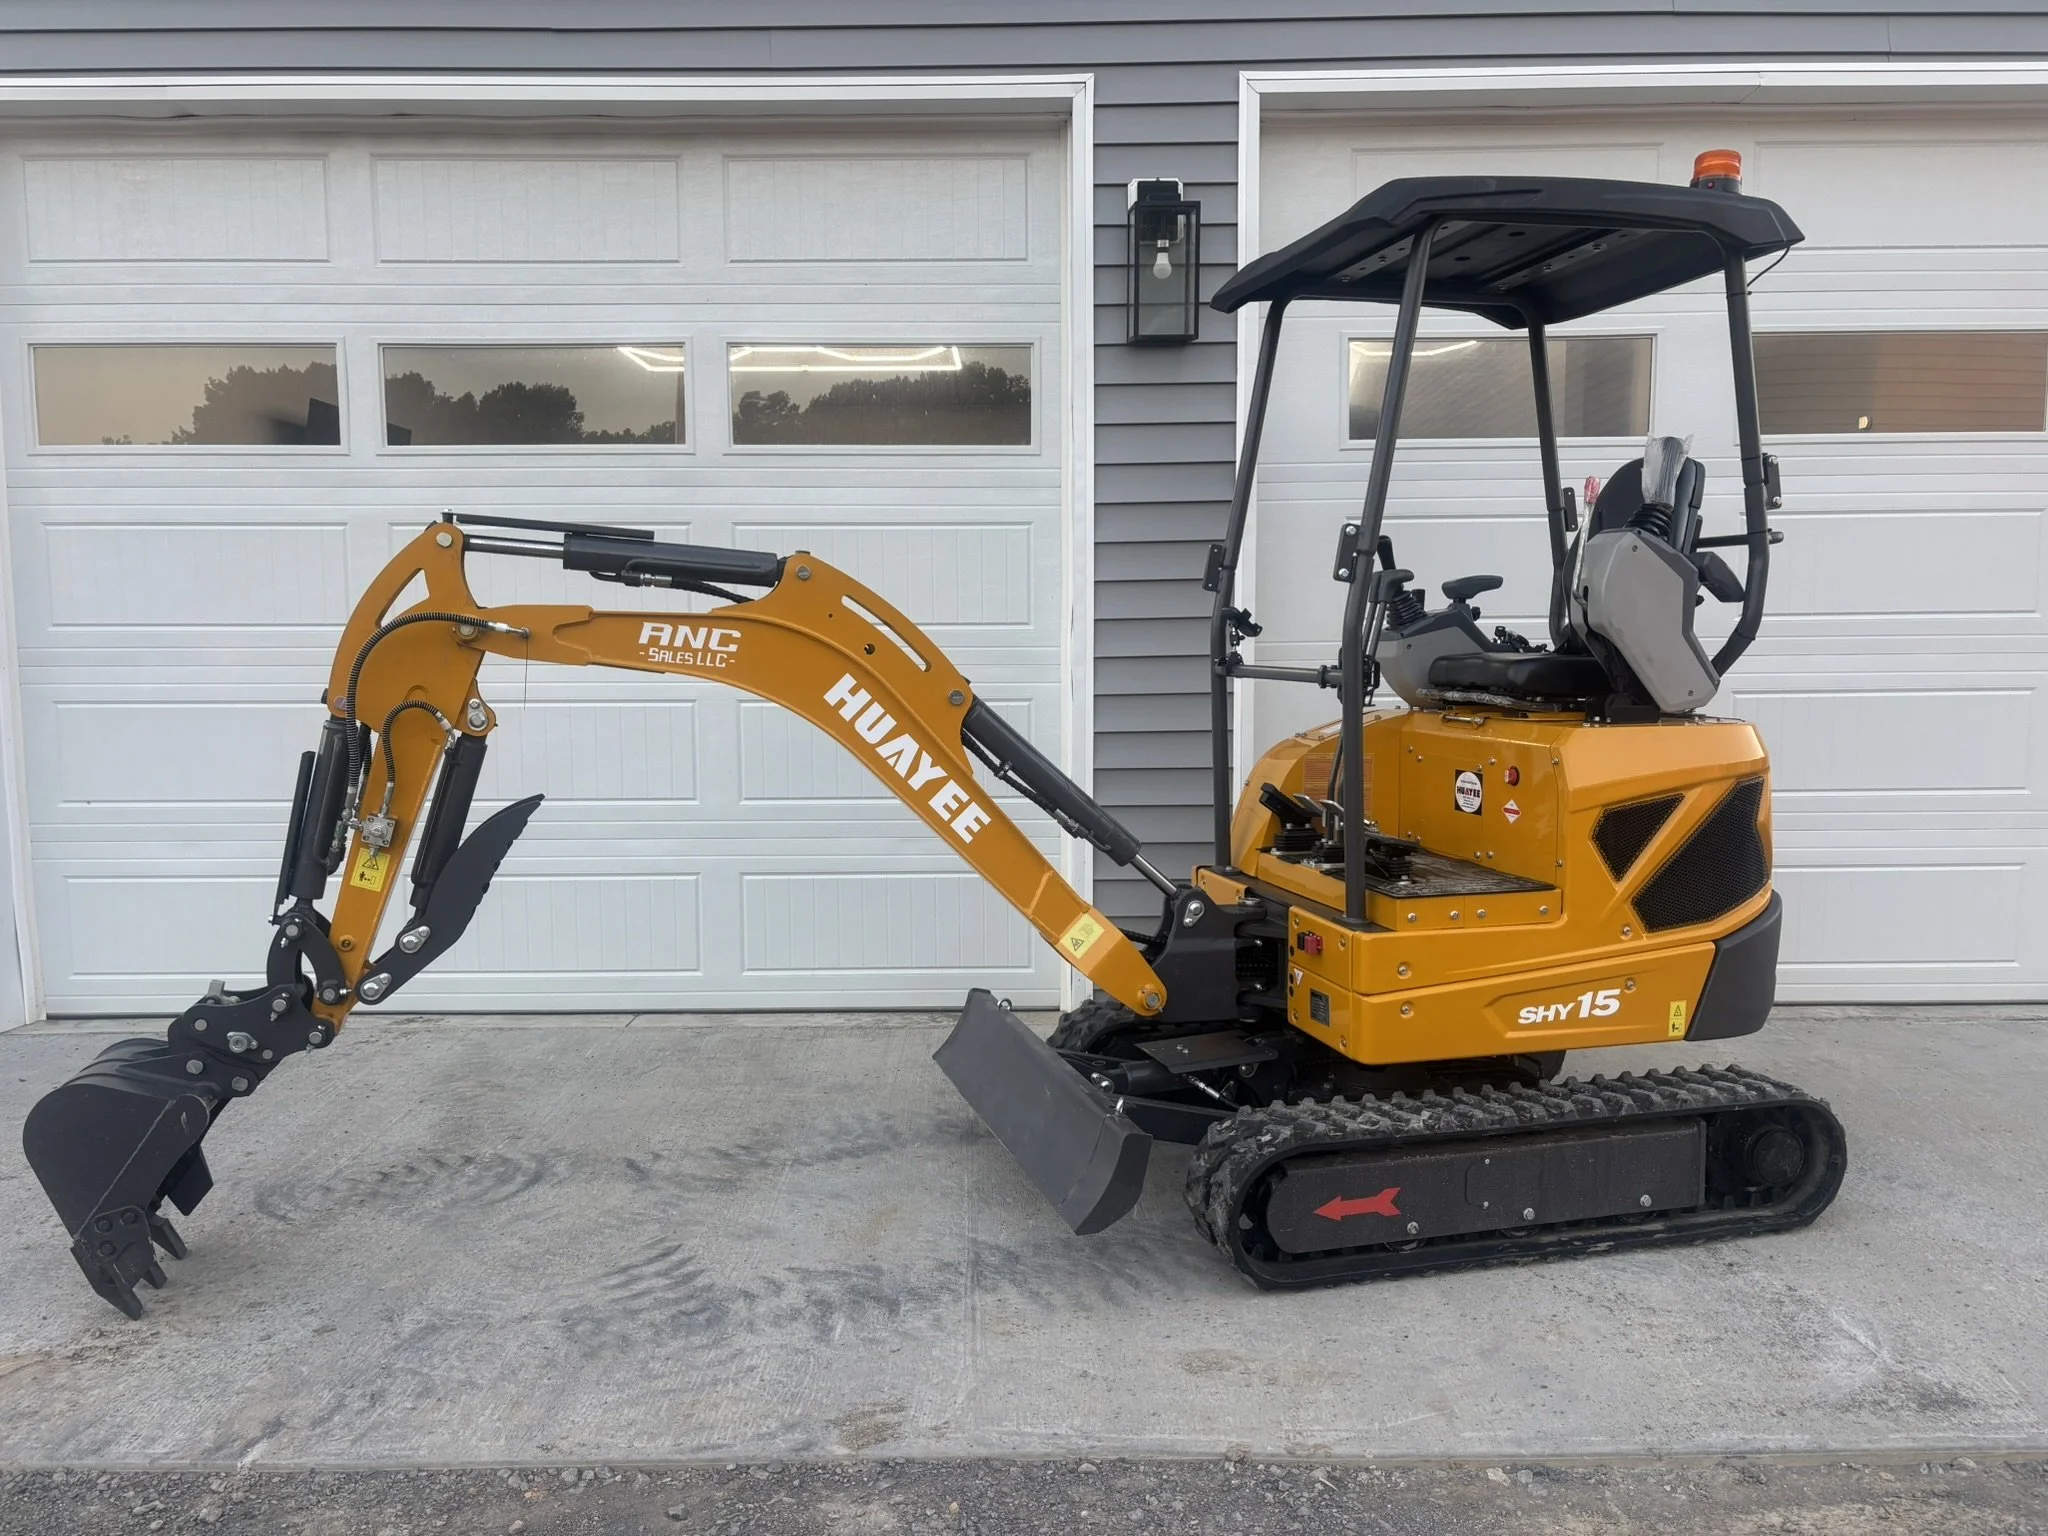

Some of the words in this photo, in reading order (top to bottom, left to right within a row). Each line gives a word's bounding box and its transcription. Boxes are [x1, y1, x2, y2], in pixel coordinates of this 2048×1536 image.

[638, 622, 741, 652] ANC
[648, 648, 693, 665] SALES
[697, 651, 727, 667] LLC
[823, 673, 992, 843] HUAYEE
[1456, 786, 1480, 798] HUAYEE
[1518, 1002, 1576, 1024] SHY
[1577, 989, 1621, 1018] 15
